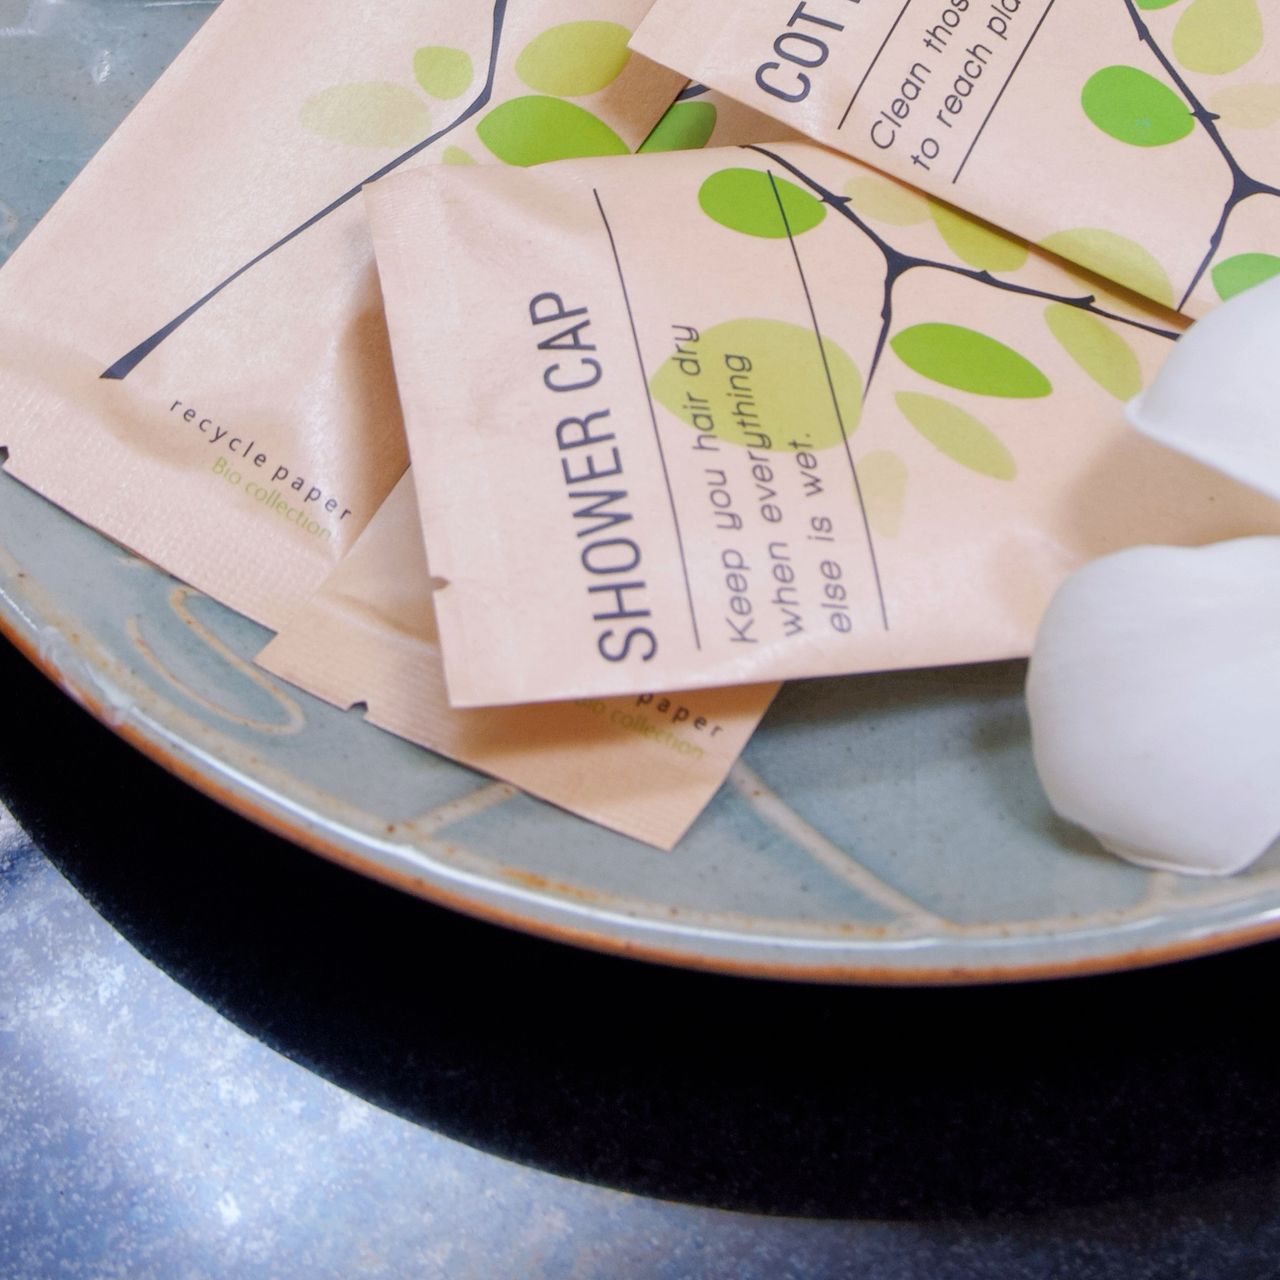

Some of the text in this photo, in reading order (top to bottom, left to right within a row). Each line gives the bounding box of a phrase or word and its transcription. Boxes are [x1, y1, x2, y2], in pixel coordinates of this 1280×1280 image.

[870, 61, 932, 150] Clean
[910, 136, 940, 172] to
[936, 42, 994, 129] reach
[169, 399, 352, 521] recycle paper
[211, 455, 333, 539] Bio collection
[528, 290, 658, 663] SHOWER CAP
[670, 323, 759, 645] Keep you hair dry
[722, 352, 804, 637] when everything
[788, 431, 853, 634] else is wet.
